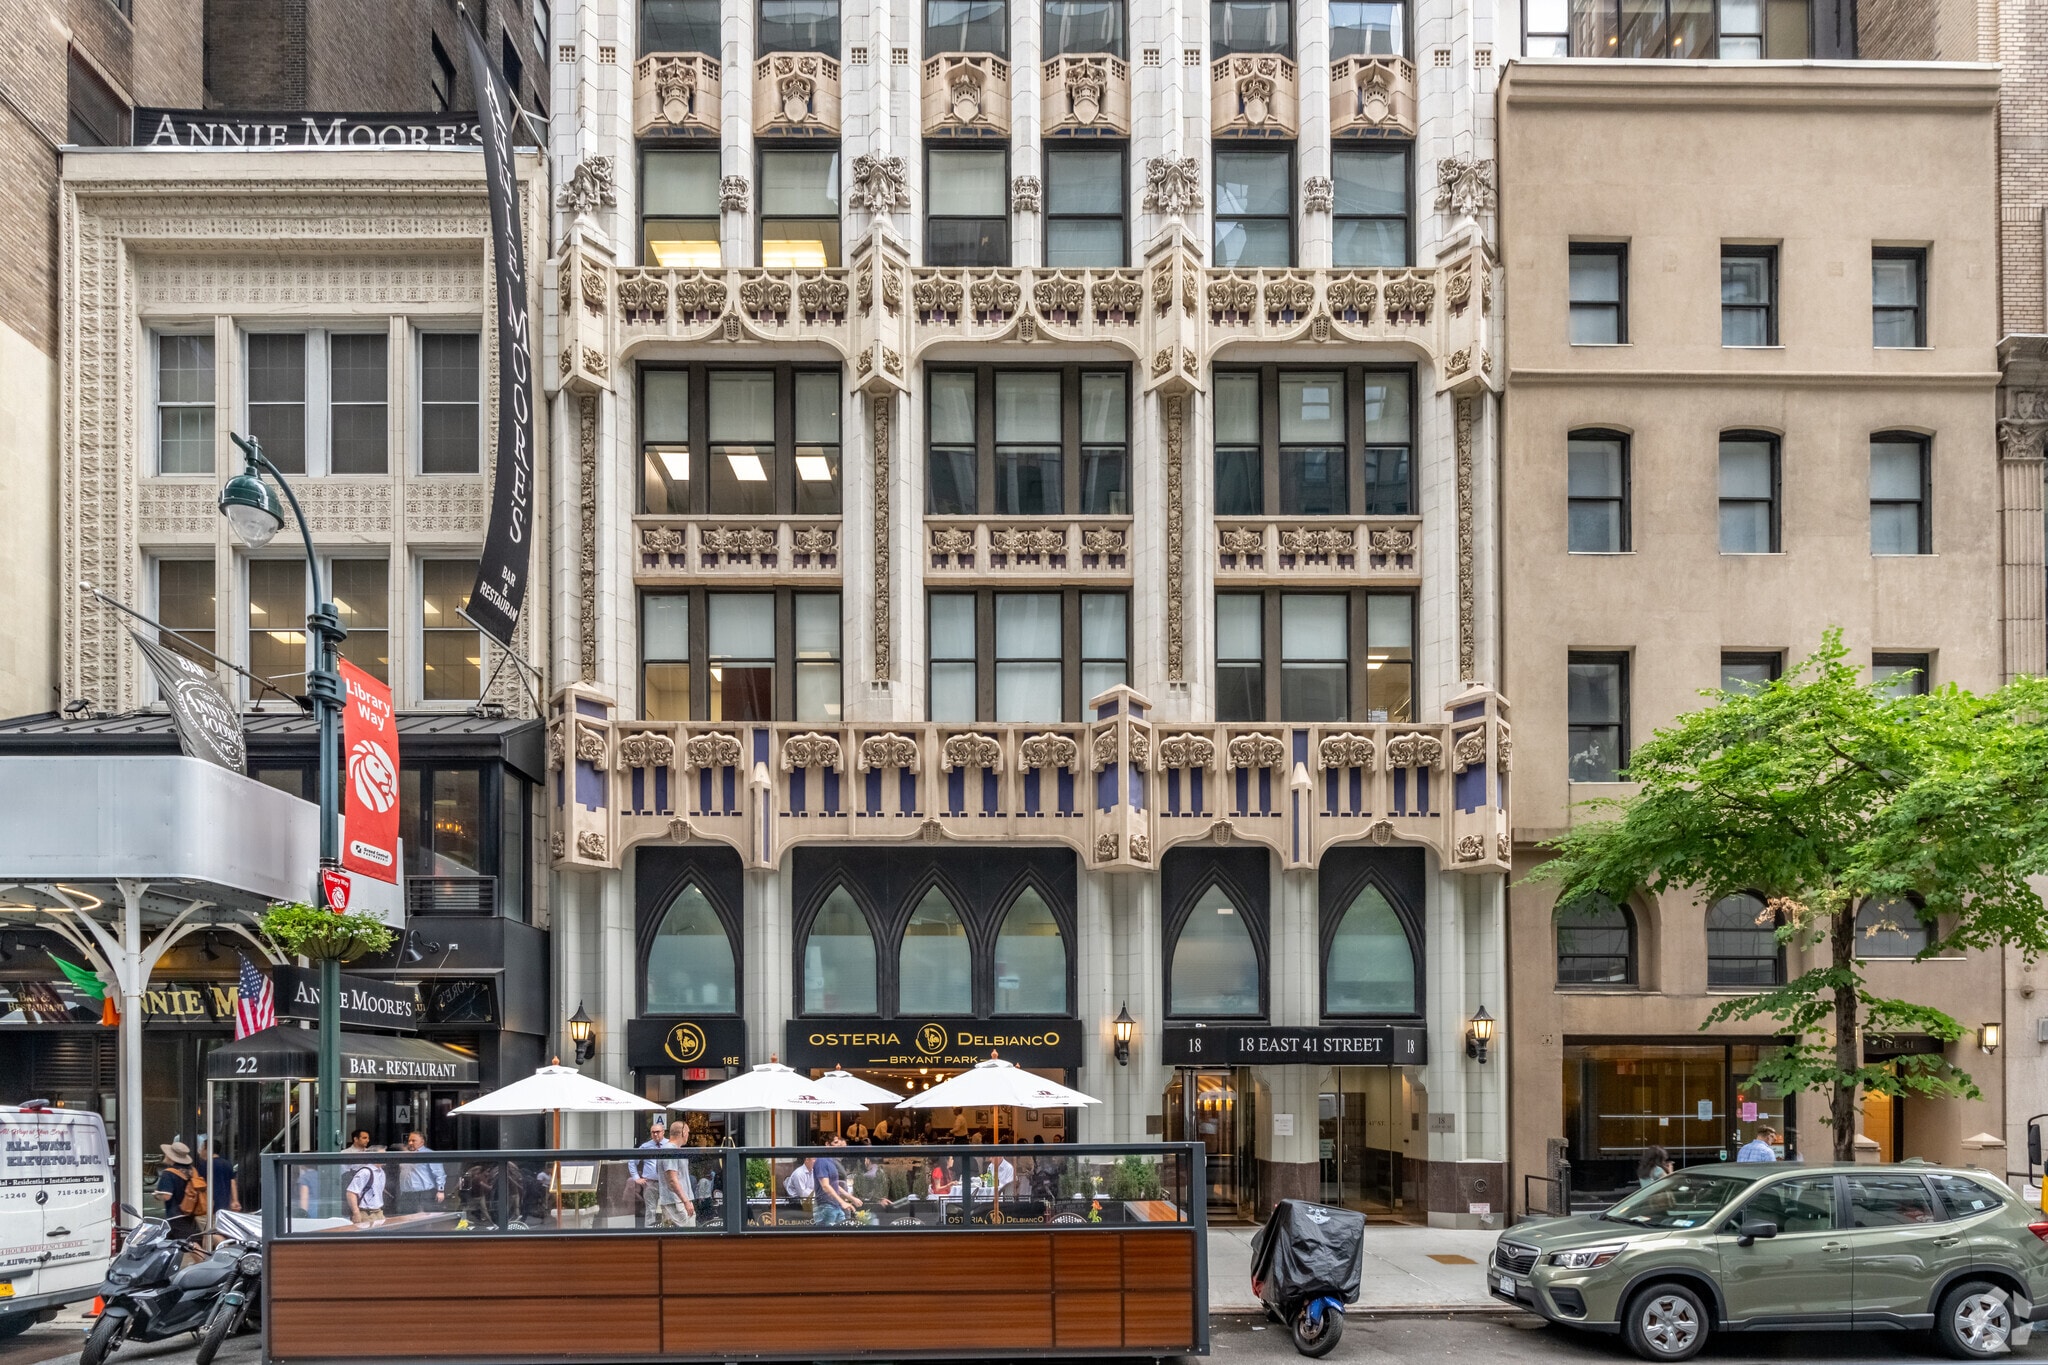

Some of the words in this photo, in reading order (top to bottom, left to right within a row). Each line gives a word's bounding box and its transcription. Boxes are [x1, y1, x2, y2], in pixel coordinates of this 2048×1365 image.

[151, 114, 288, 146] ANNIE
[501, 564, 516, 587] BAR
[502, 583, 509, 597] &
[479, 580, 519, 622] RESTAURAN
[346, 679, 391, 718] Library
[357, 702, 385, 732] Way
[351, 989, 412, 1017] MOORE'S
[808, 1032, 901, 1046] OSTERIA
[957, 1031, 1060, 1047] DELBIANCO
[1188, 1038, 1202, 1053] 18
[1239, 1037, 1255, 1052] 18
[1258, 1037, 1300, 1052] EAST
[1302, 1037, 1319, 1052] 41
[1323, 1037, 1384, 1053] STREET
[1407, 1039, 1415, 1054] 18
[235, 1056, 258, 1074] 22
[350, 1058, 376, 1075] BAR
[386, 1061, 457, 1078] RESTAURANT
[722, 1056, 740, 1066] 18E
[889, 1055, 940, 1065] BRYANT
[944, 1055, 979, 1065] PARK
[398, 1107, 408, 1119] A
[656, 1115, 665, 1126] A
[6, 1140, 72, 1152] ALL-WAYS
[1006, 1215, 1044, 1224] DELBIANCO
